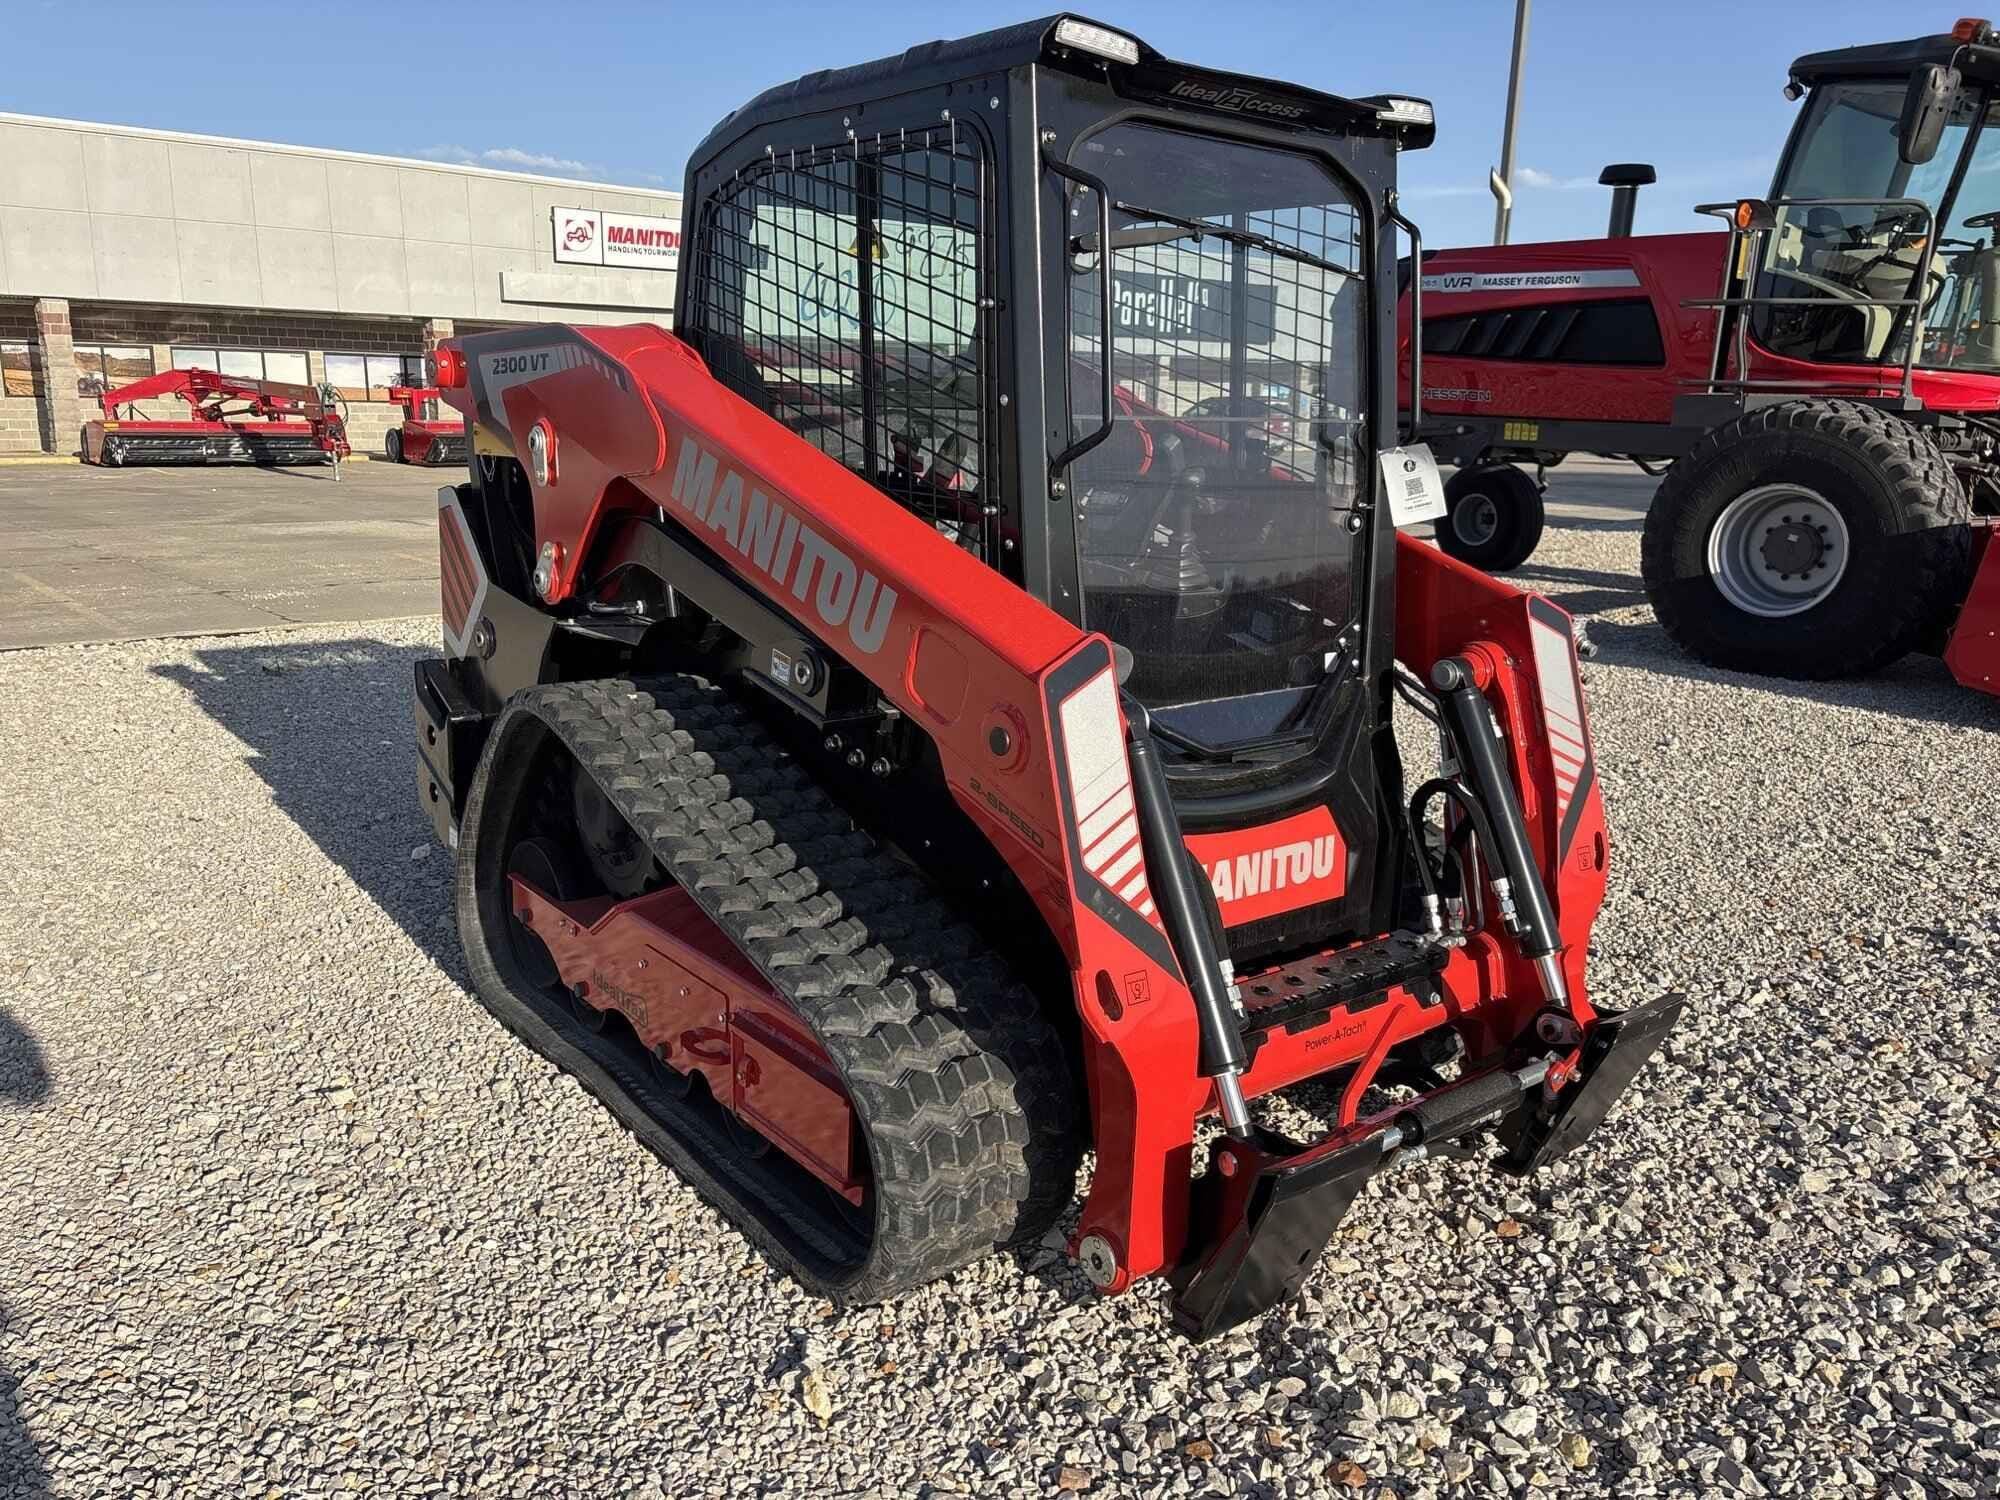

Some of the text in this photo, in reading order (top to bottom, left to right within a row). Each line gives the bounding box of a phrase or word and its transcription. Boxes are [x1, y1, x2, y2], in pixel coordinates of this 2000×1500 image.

[608, 245, 642, 255] HANDLING
[644, 248, 661, 256] YOUR
[1443, 276, 1473, 289] WR
[1482, 276, 1522, 286] MASSEY
[1525, 275, 1581, 286] FERGUSON
[492, 353, 549, 375] 2300 VT
[1422, 387, 1492, 401] HESSTON
[671, 435, 898, 654] MANITOU
[1201, 834, 1336, 903] ANITOU
